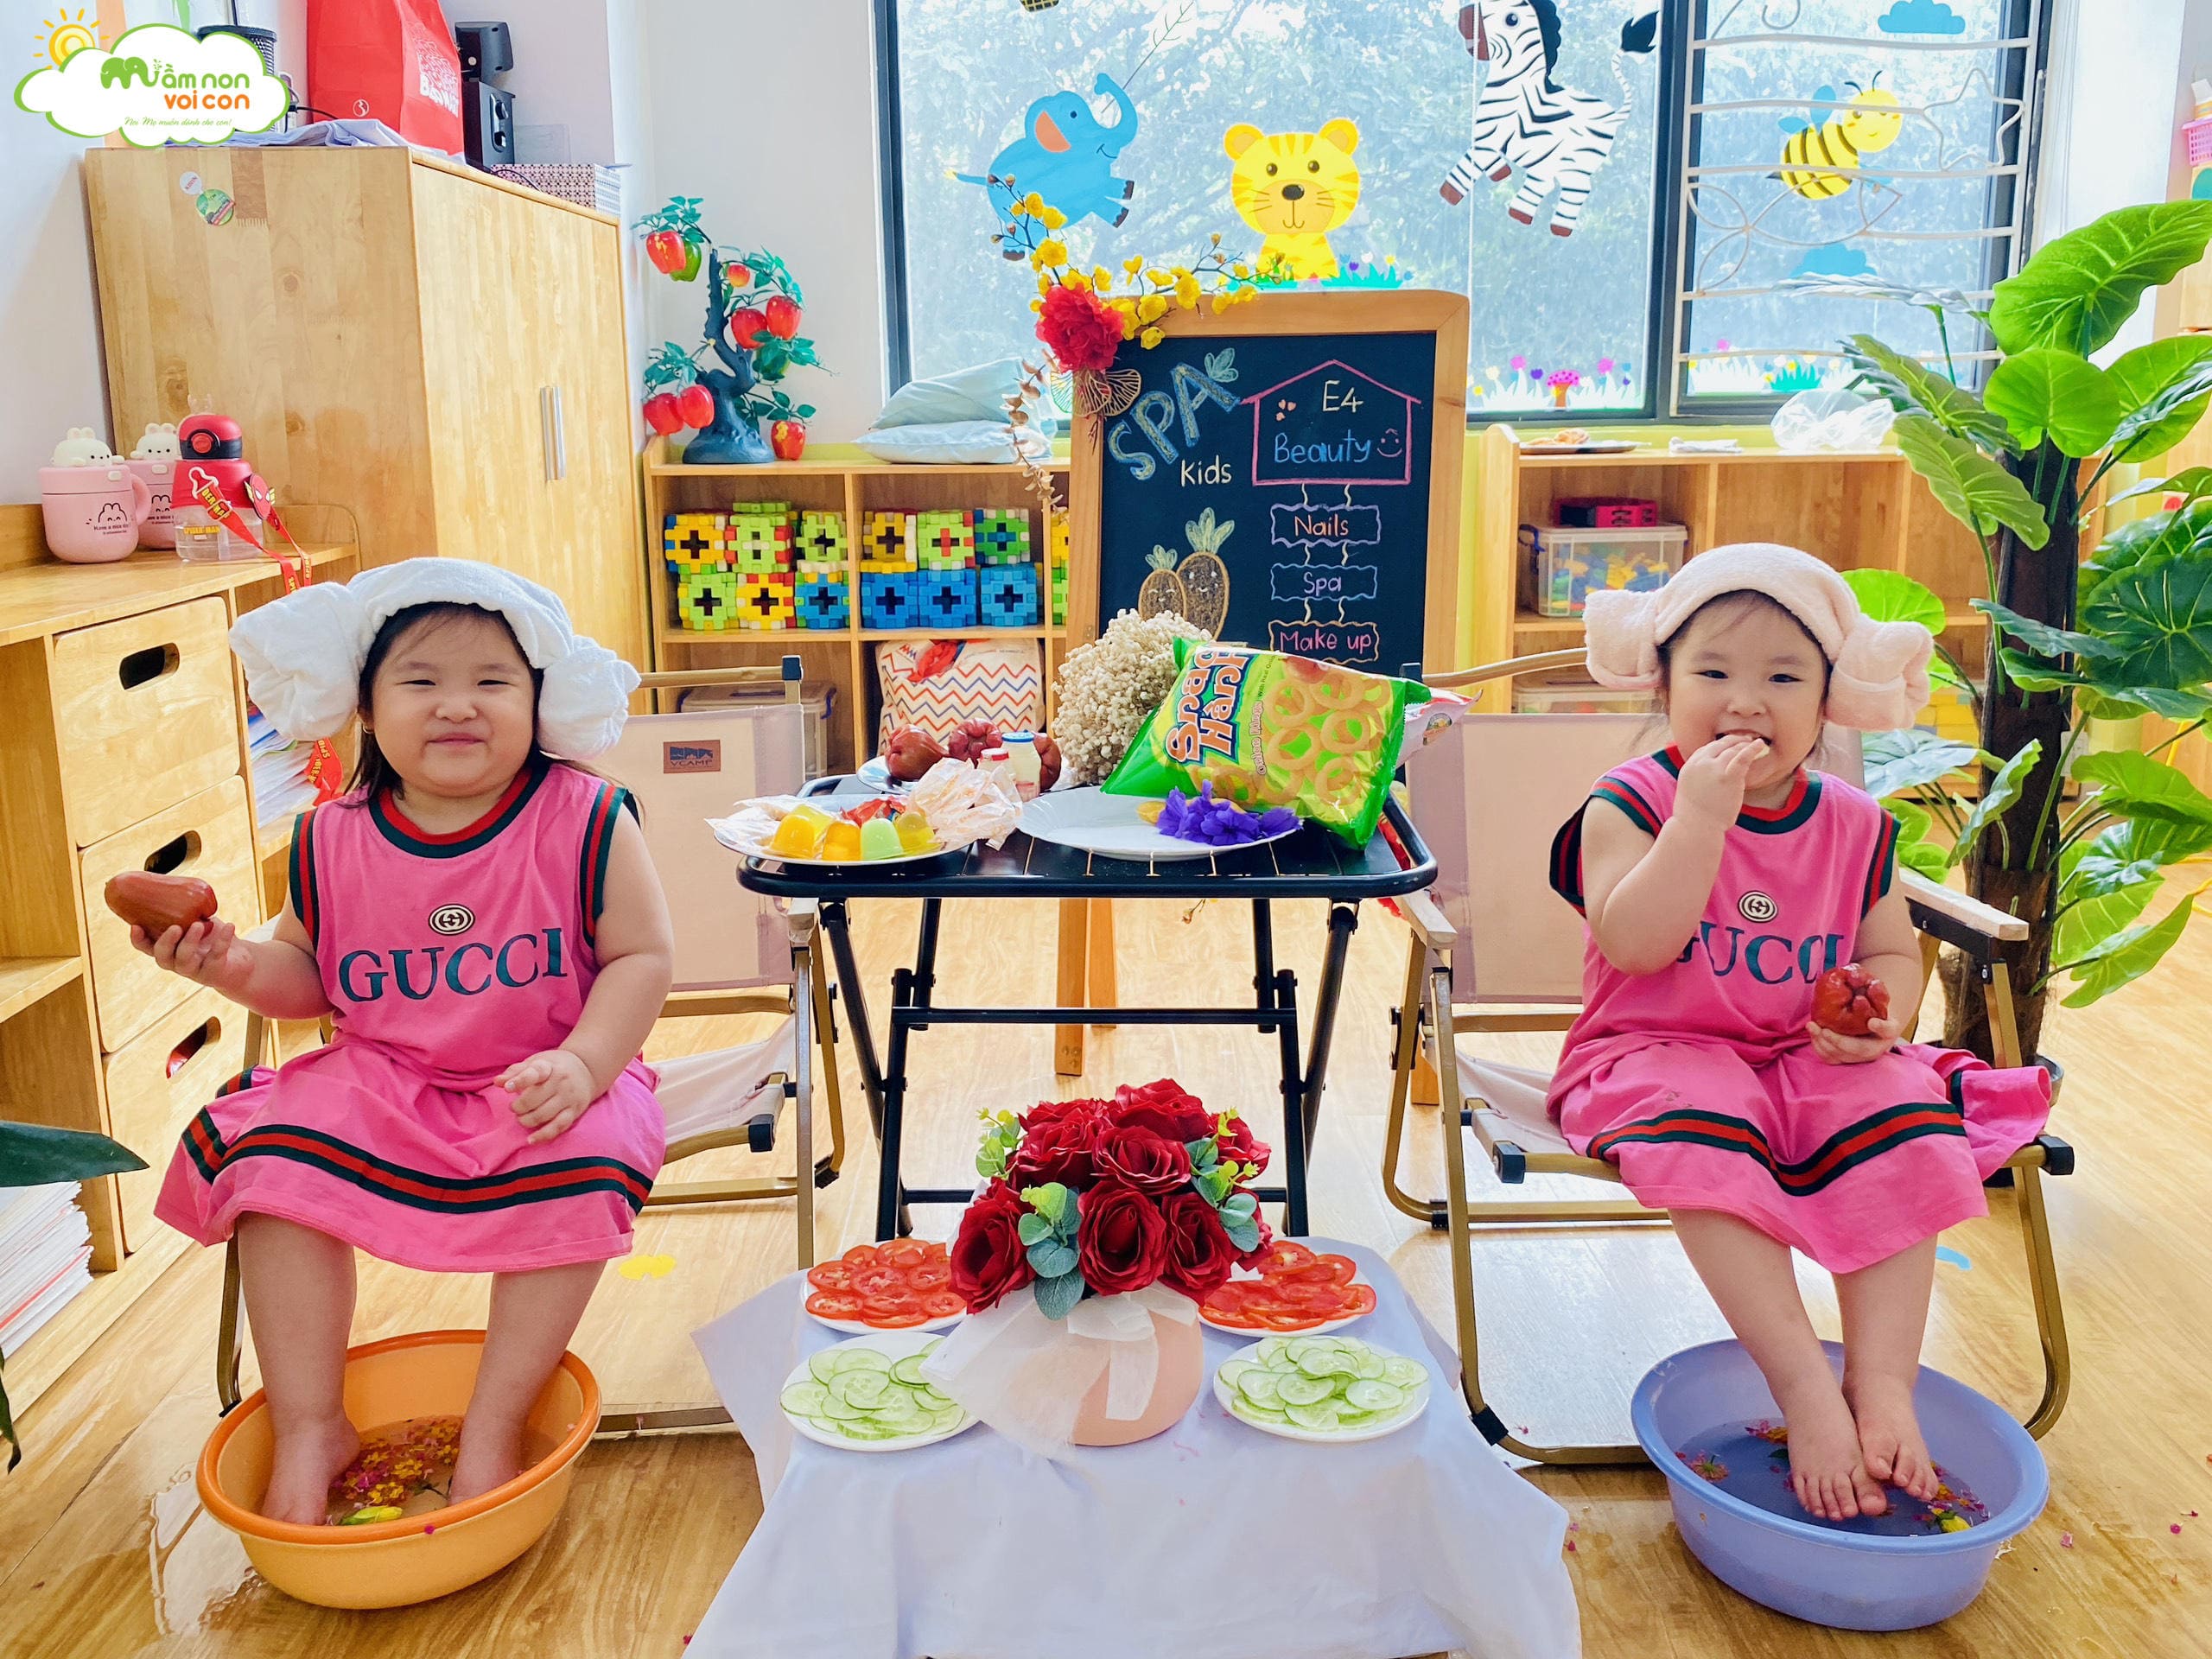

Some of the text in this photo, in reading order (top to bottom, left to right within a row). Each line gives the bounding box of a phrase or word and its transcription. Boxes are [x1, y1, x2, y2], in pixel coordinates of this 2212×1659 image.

[1322, 379, 1363, 413] E4
[1108, 362, 1241, 480] SPA
[1274, 429, 1371, 464] Beauty
[1294, 514, 1350, 537] Nails
[1303, 574, 1343, 594] Spa
[1280, 631, 1373, 654] Make up
[339, 927, 568, 1002] GUCCI
